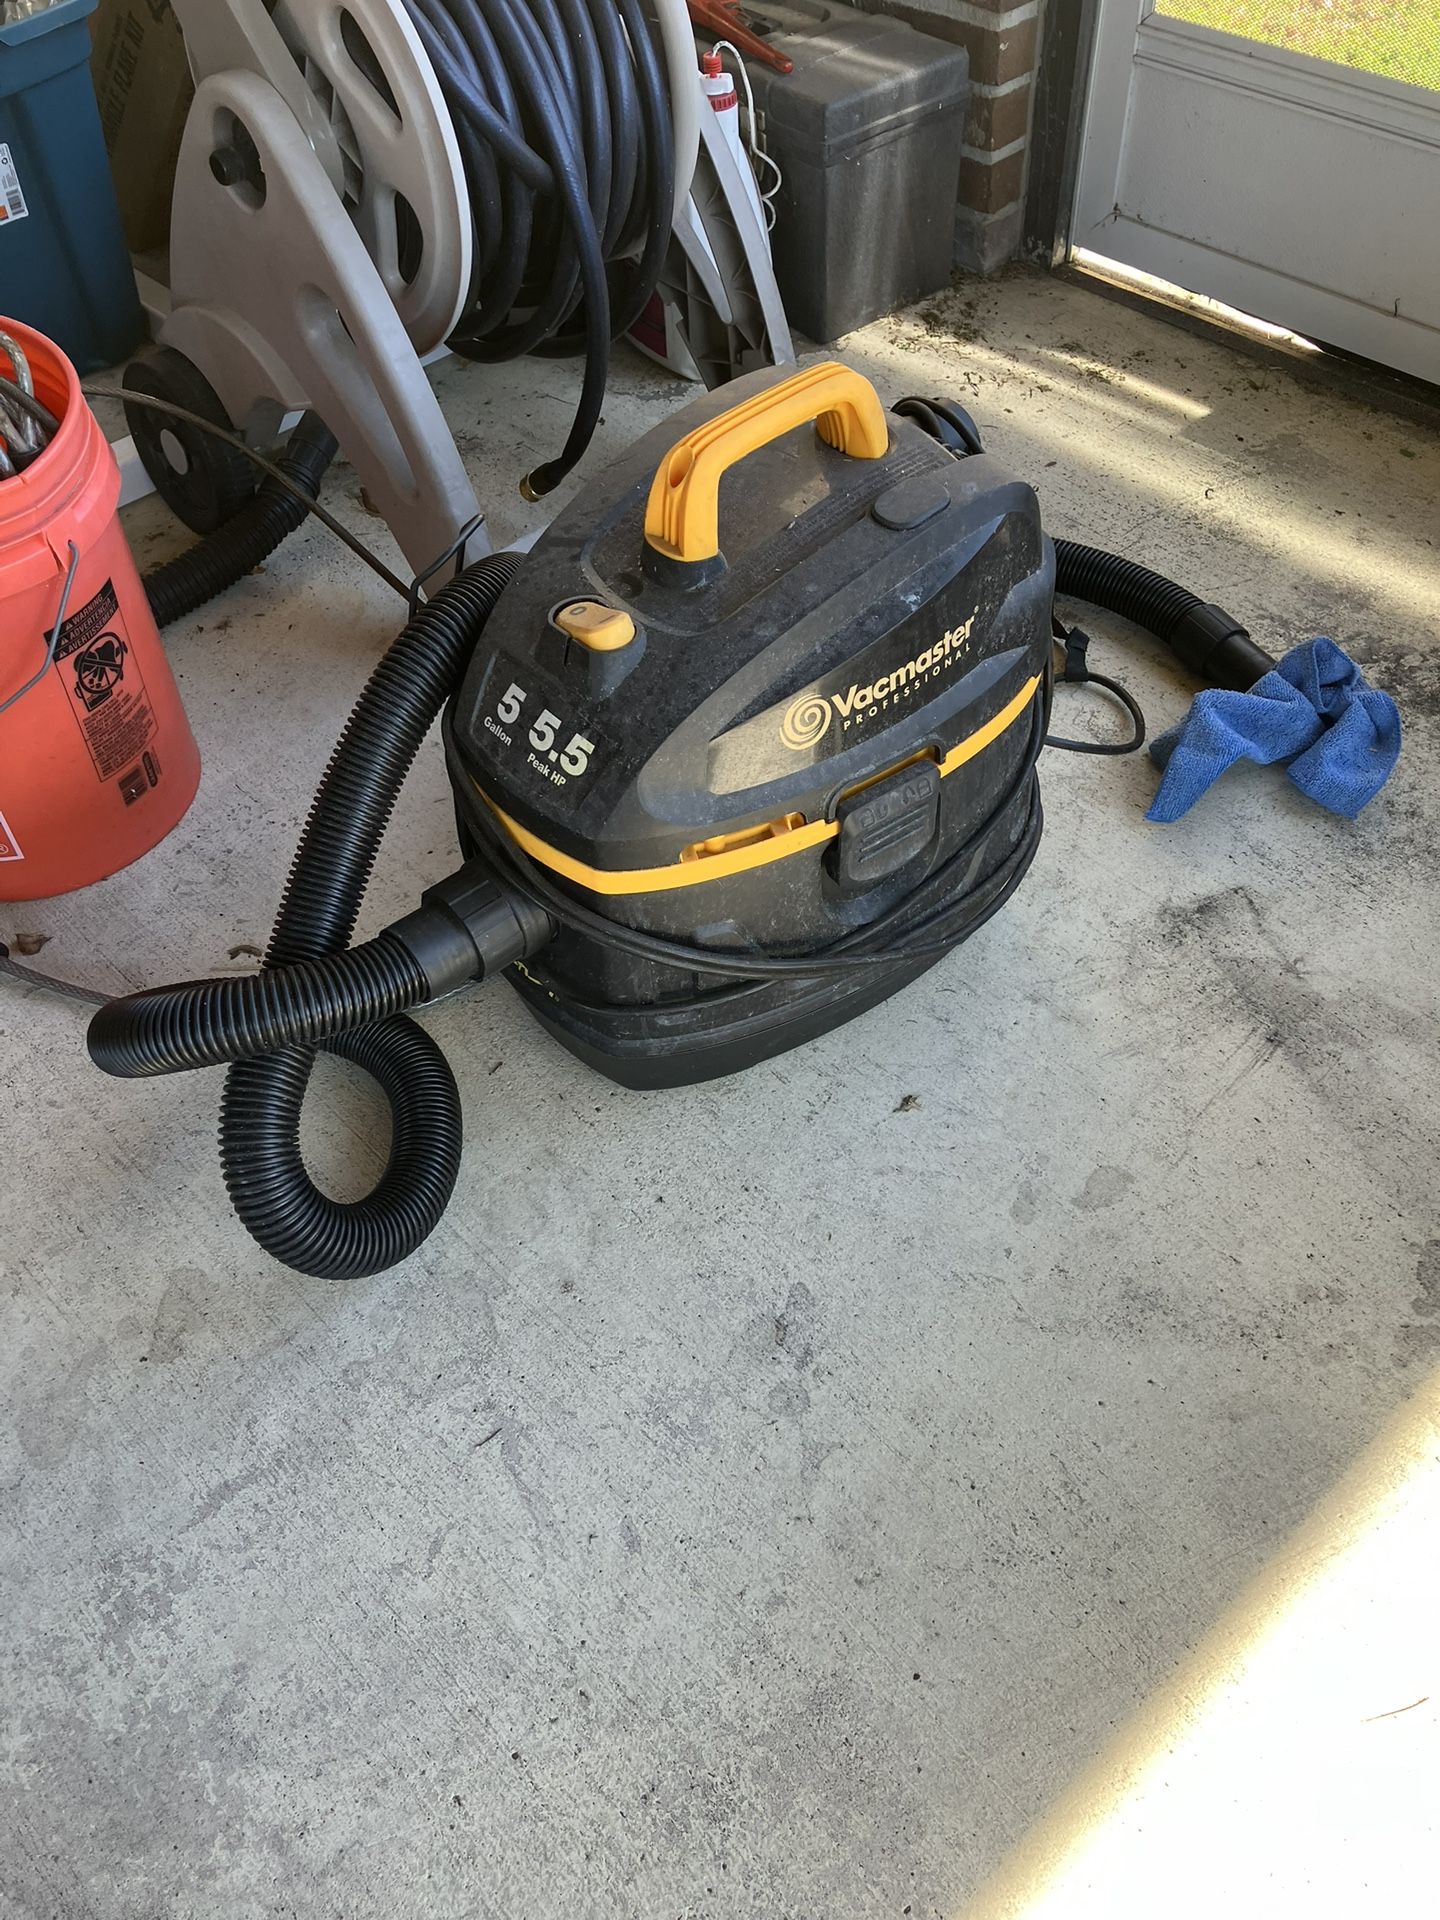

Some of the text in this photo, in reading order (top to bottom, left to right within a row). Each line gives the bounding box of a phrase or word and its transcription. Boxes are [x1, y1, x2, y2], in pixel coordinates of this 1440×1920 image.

[68, 602, 116, 652] AVERTISSEMENT
[70, 597, 111, 640] ADVERTENCIA
[72, 593, 103, 624] WARNING
[831, 615, 975, 718] Vacmaster
[843, 643, 971, 731] PROFESSIONAL
[497, 682, 528, 724] 5
[483, 716, 512, 747] Gallon
[528, 708, 596, 777] 5.5
[527, 752, 567, 787] Peak HP
